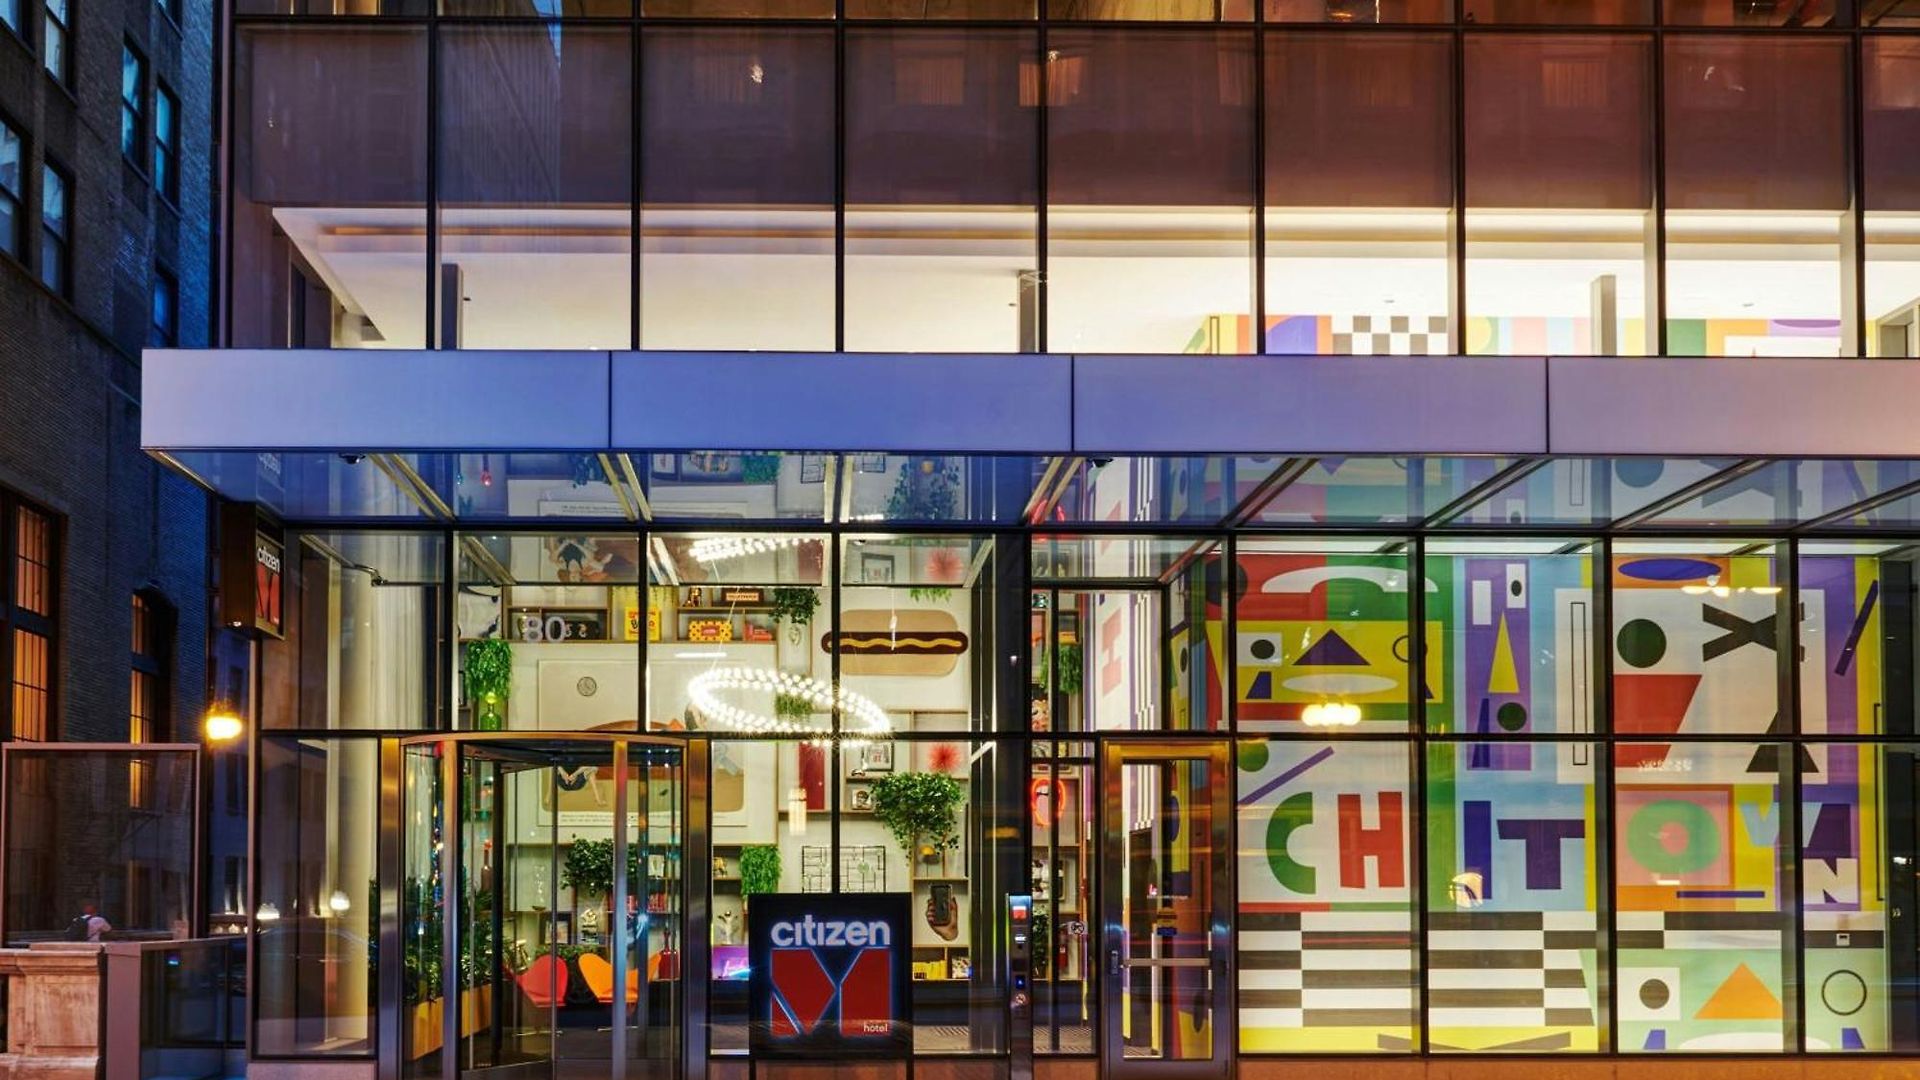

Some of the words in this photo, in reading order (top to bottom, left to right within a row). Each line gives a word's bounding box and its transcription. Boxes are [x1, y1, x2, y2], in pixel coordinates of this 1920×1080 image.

[257, 545, 280, 574] citizen
[523, 616, 566, 643] 80
[770, 914, 891, 947] citizen
[863, 1022, 889, 1033] hotel
